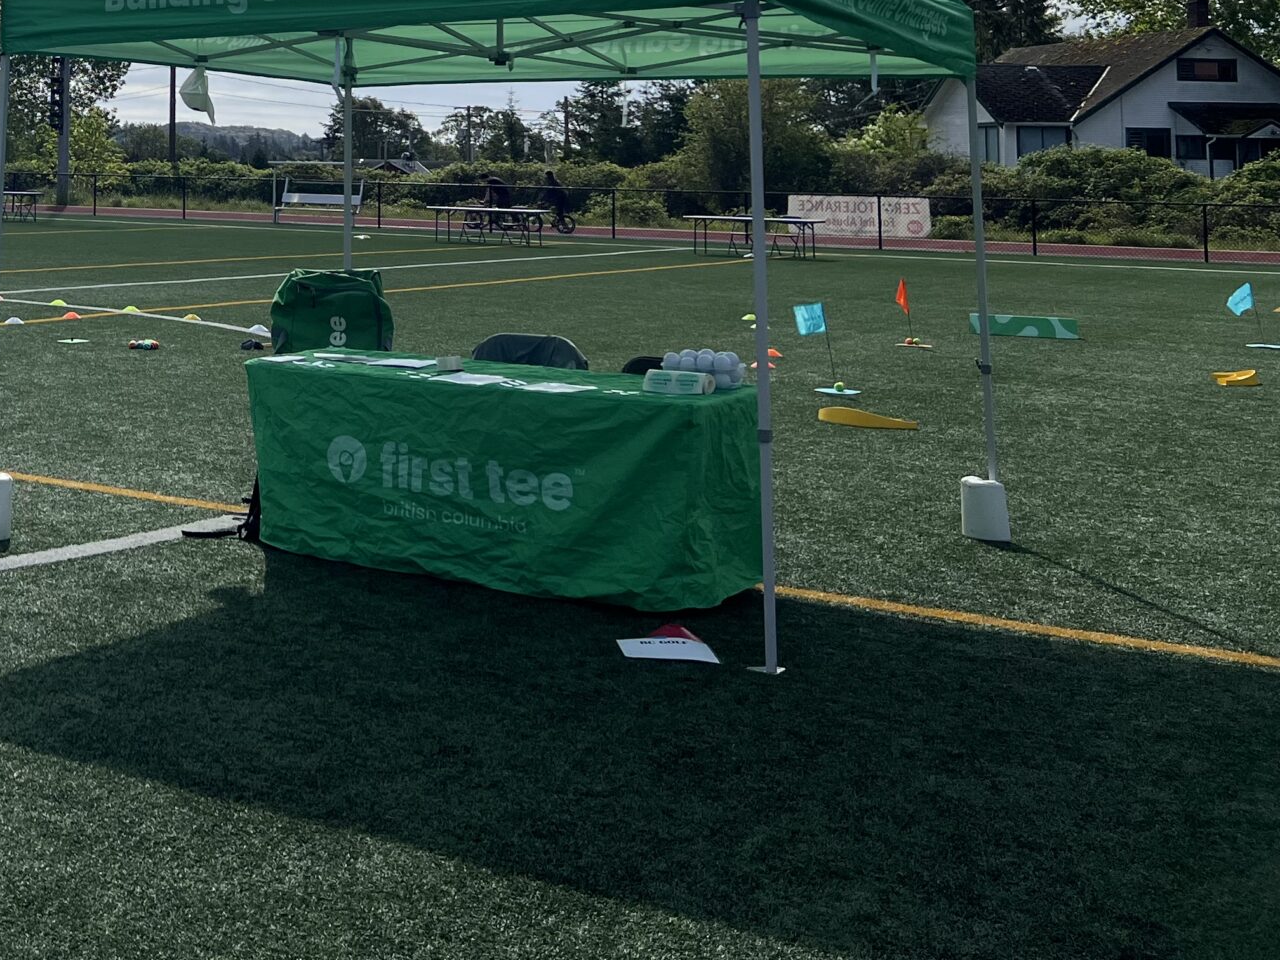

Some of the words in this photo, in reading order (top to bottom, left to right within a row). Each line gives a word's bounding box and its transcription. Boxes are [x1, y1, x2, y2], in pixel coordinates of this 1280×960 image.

[380, 441, 474, 500] first
[485, 459, 573, 511] tee
[383, 499, 436, 522] british
[442, 508, 528, 533] columbia
